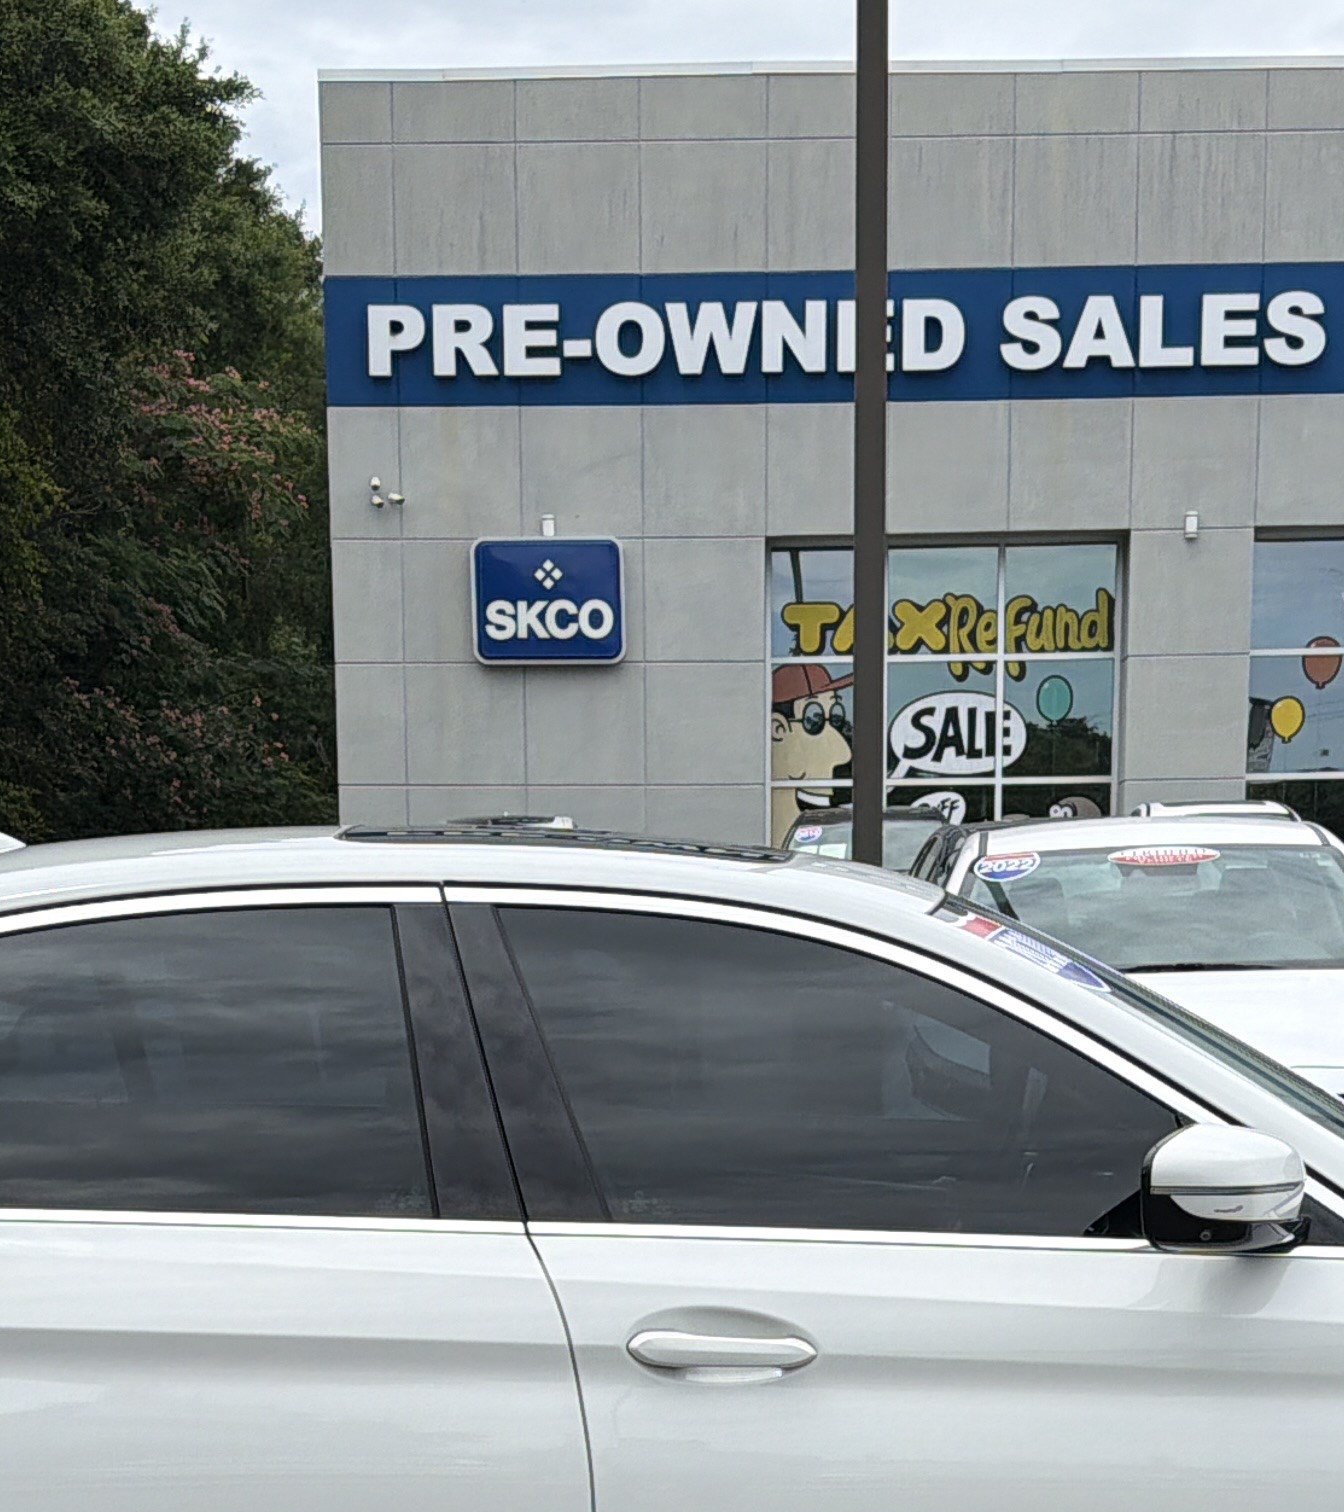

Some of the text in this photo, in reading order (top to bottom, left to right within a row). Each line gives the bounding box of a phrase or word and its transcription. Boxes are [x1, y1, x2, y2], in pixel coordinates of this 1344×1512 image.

[1000, 291, 1327, 370] SALES
[485, 598, 614, 641] SKCO
[902, 706, 1012, 763] SALE
[978, 858, 1035, 873] 2022
